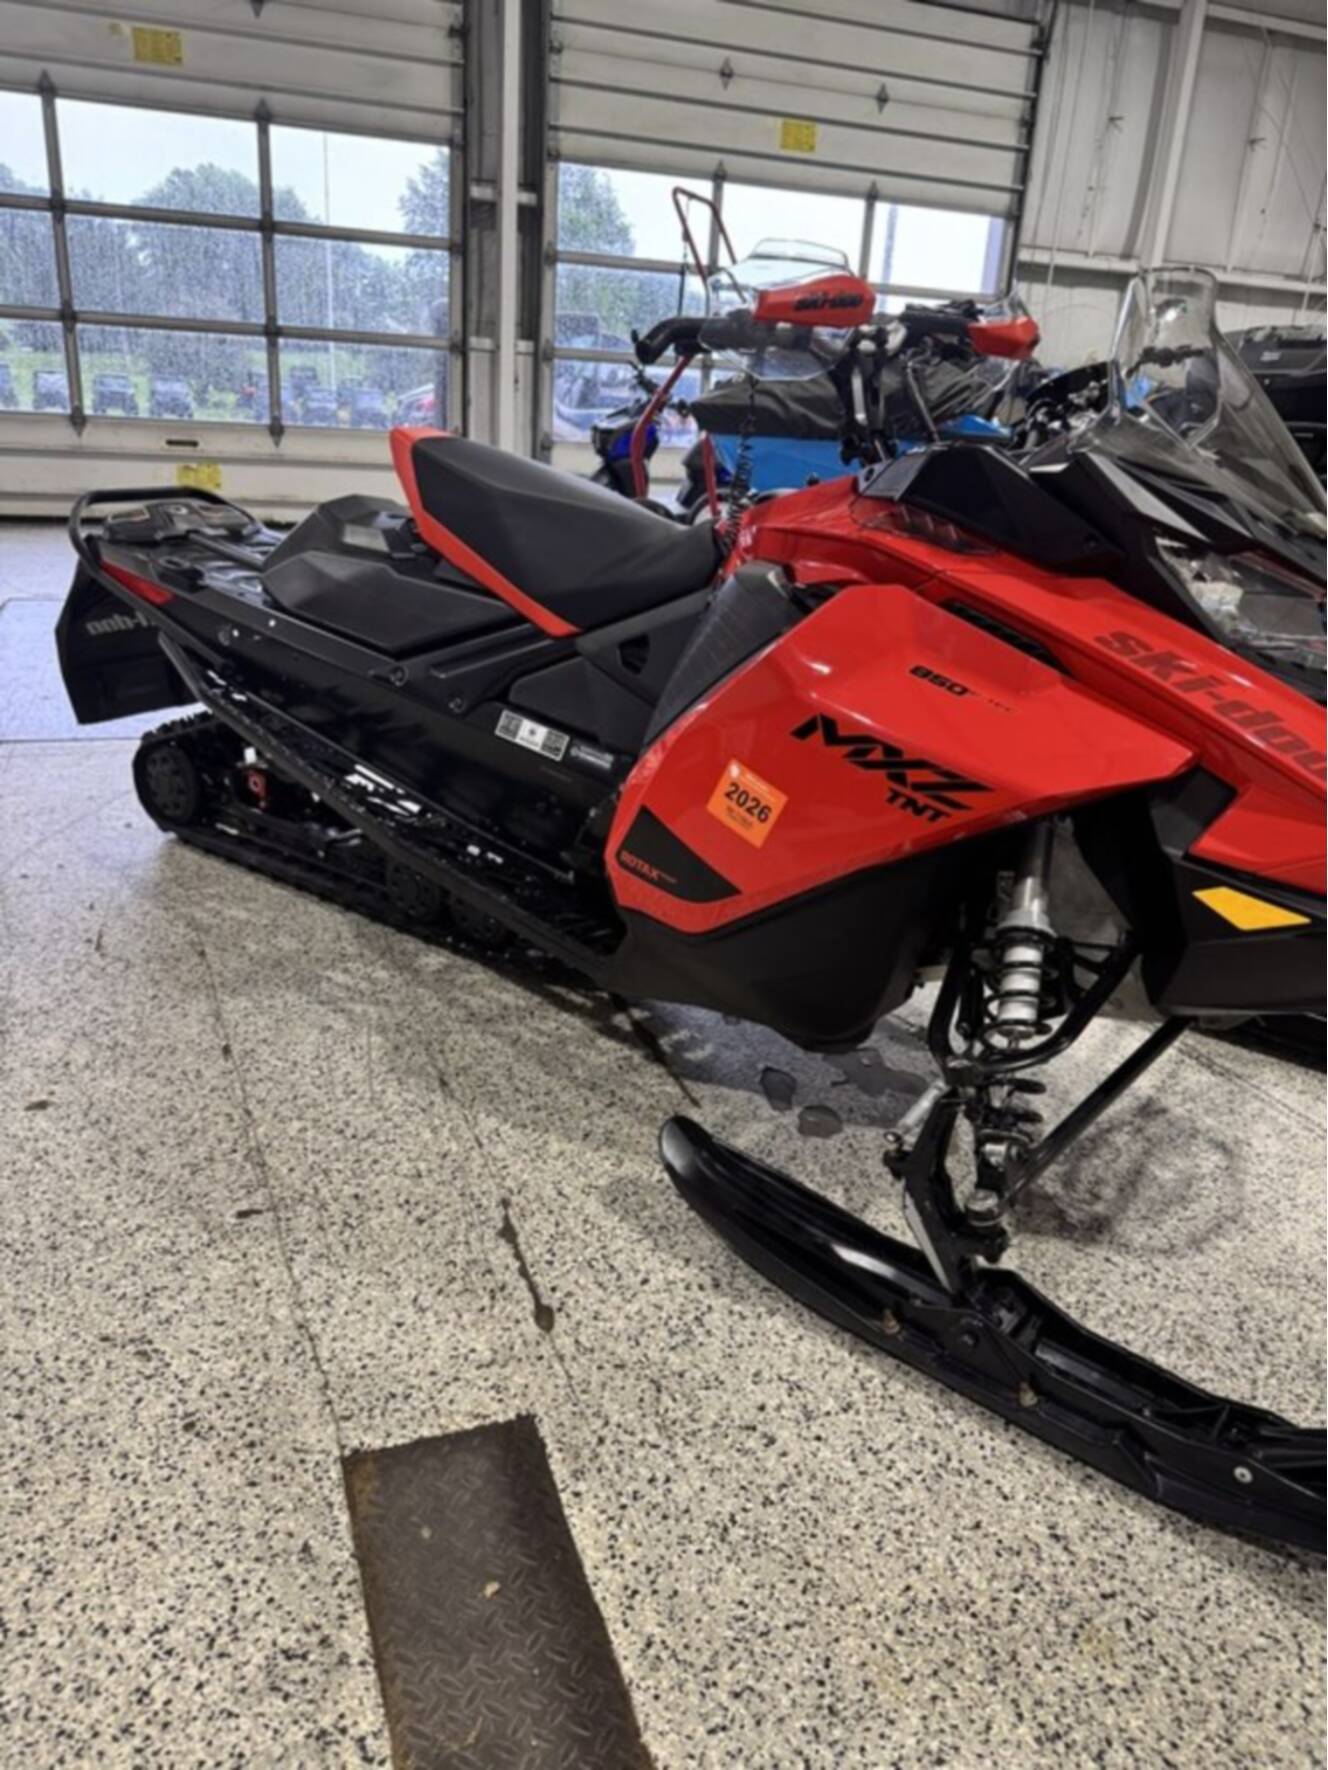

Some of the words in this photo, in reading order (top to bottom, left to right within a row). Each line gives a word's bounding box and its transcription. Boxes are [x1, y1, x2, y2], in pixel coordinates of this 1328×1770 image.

[909, 664, 970, 697] 850
[789, 713, 995, 812] MXZ
[724, 781, 773, 824] 2026
[885, 787, 952, 824] TNT
